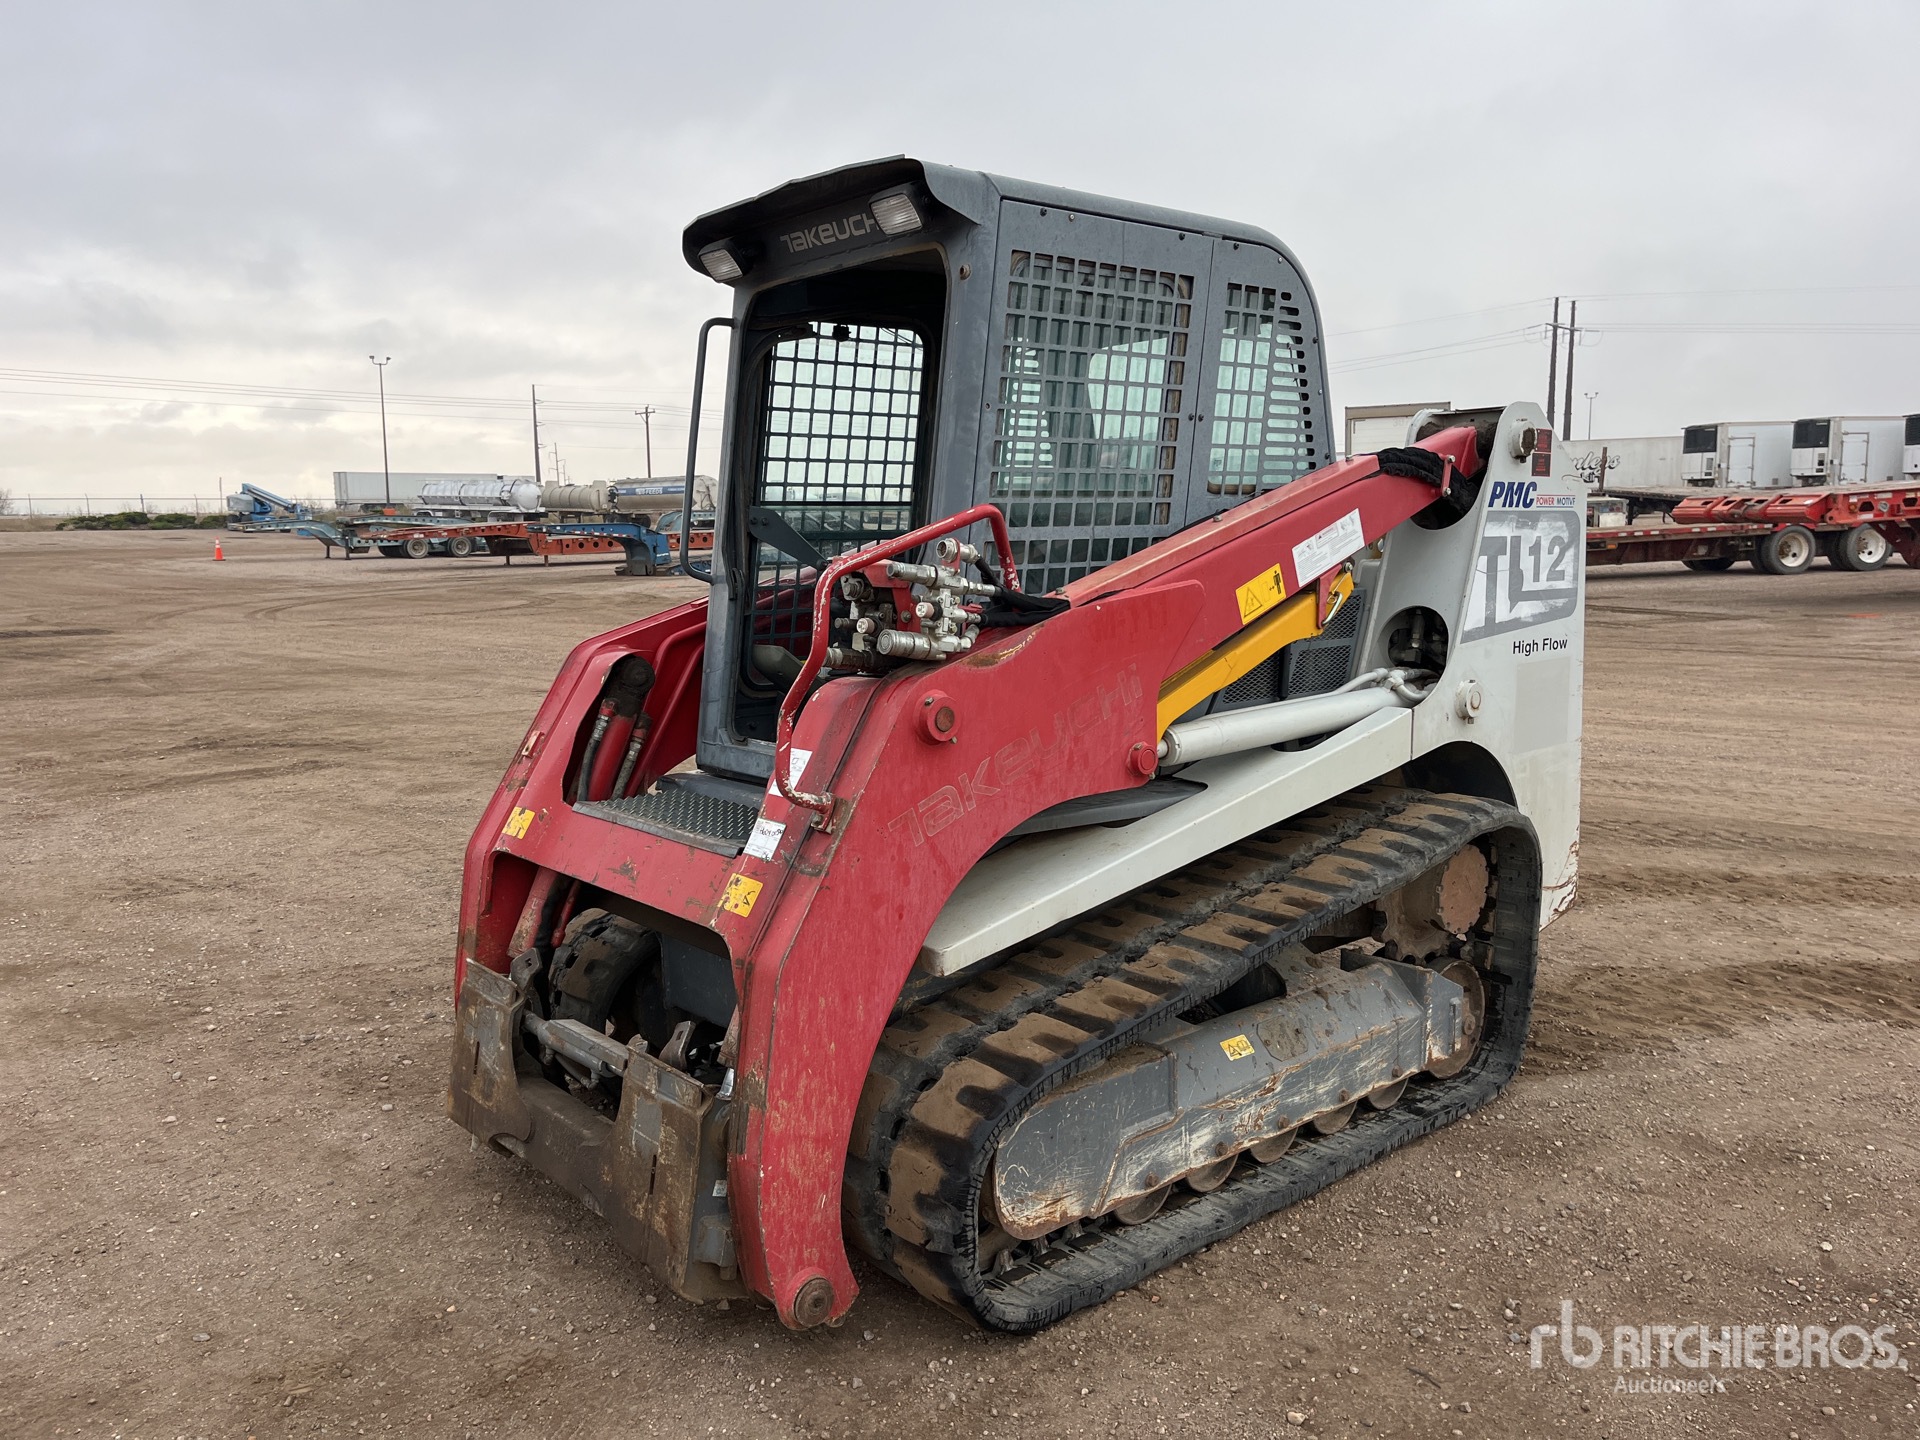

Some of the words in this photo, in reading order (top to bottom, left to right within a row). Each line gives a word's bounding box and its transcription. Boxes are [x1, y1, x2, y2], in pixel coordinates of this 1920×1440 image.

[780, 213, 880, 253] TAKEUCH
[1488, 481, 1537, 509] PMC
[1536, 497, 1554, 505] POWER
[1512, 639, 1539, 656] High
[1542, 638, 1568, 651] Flow
